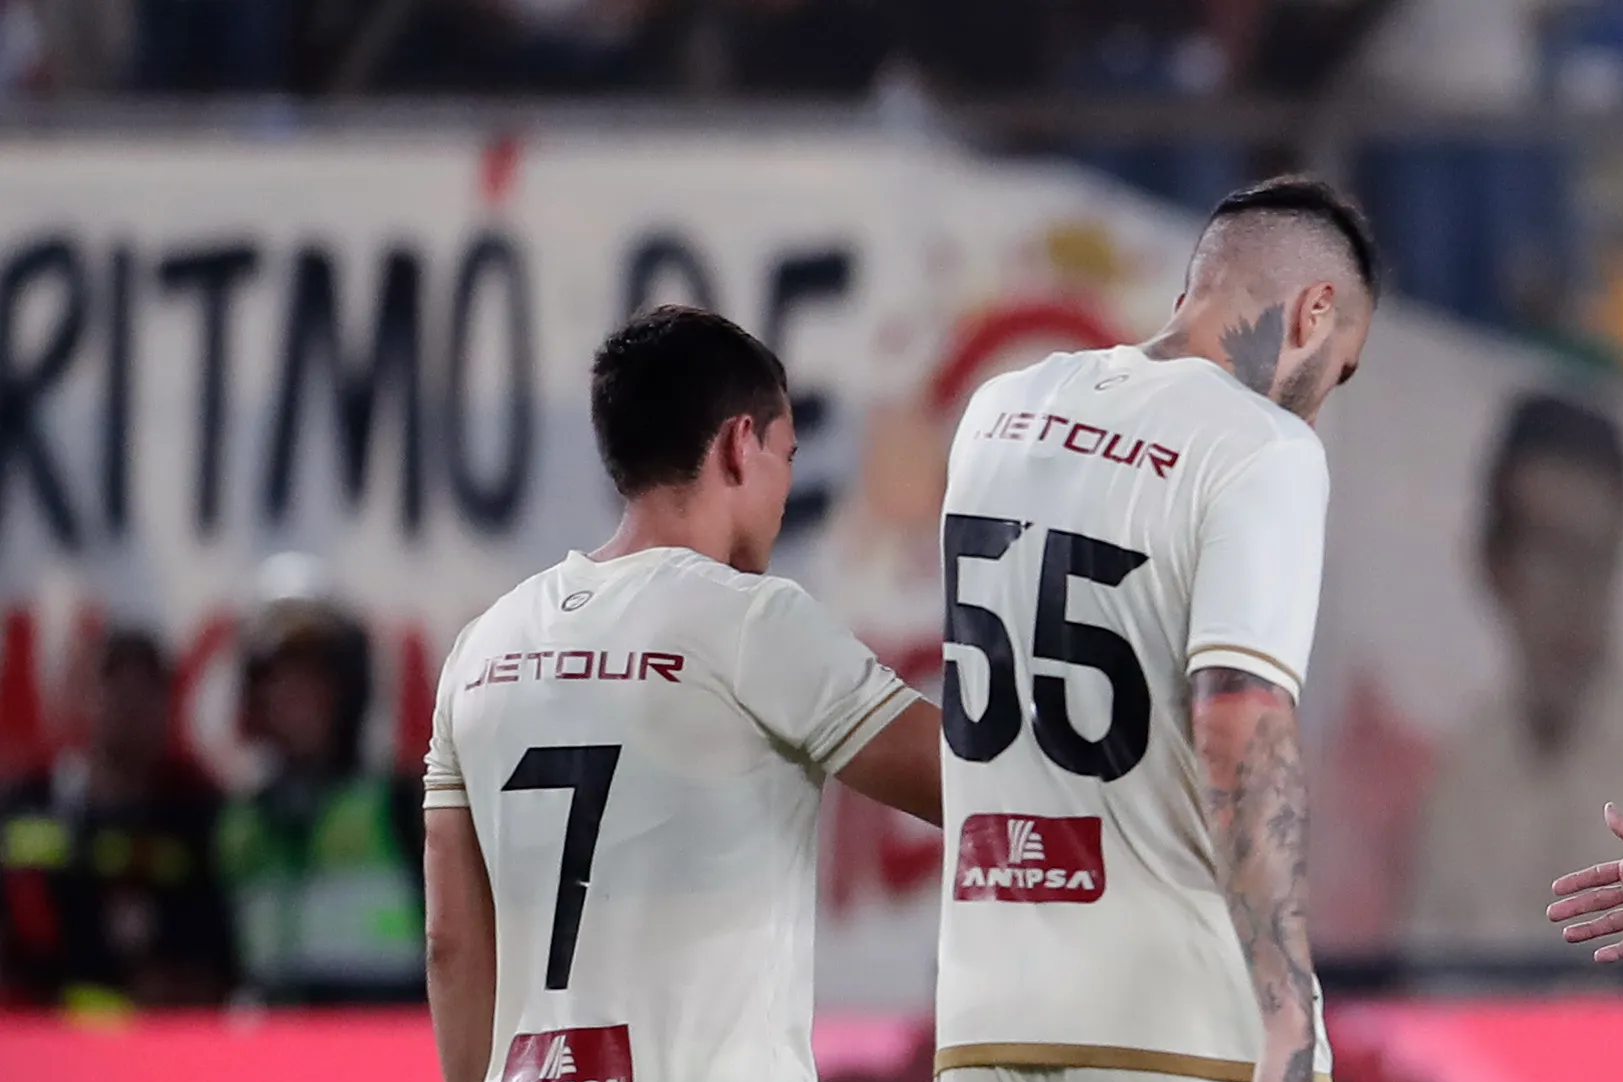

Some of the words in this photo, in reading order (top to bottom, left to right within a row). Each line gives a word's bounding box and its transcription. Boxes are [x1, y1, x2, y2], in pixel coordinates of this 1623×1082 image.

[974, 412, 1181, 479] JETOUR
[464, 650, 685, 691] JETOUR
[941, 513, 1152, 783] 55
[501, 745, 622, 990] 7
